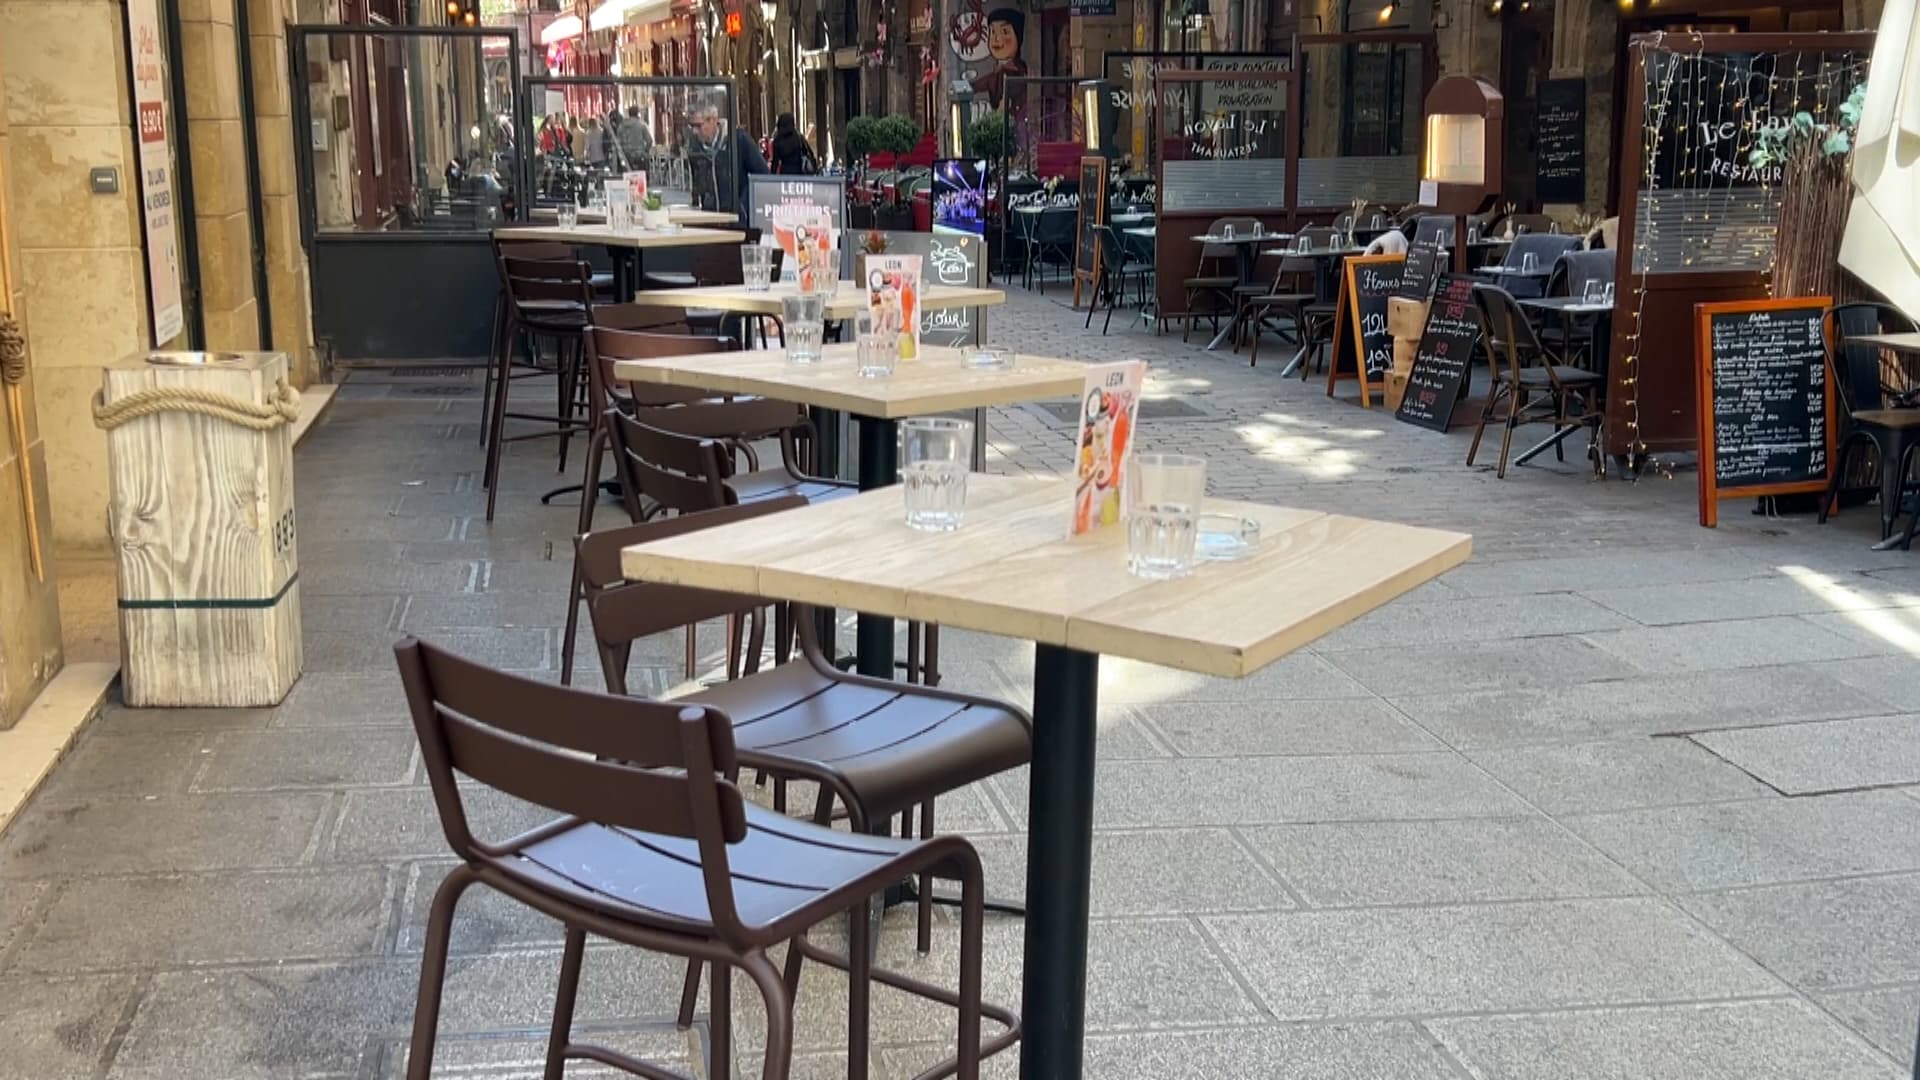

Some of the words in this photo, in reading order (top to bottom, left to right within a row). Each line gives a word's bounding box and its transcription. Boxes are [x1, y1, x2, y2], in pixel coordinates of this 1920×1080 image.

[1700, 121, 1736, 145] Le
[1751, 110, 1794, 133] Lay
[1711, 158, 1782, 181] RESTAUR
[781, 182, 814, 195] LEON
[884, 260, 902, 270] LEON
[1106, 372, 1124, 388] LEON
